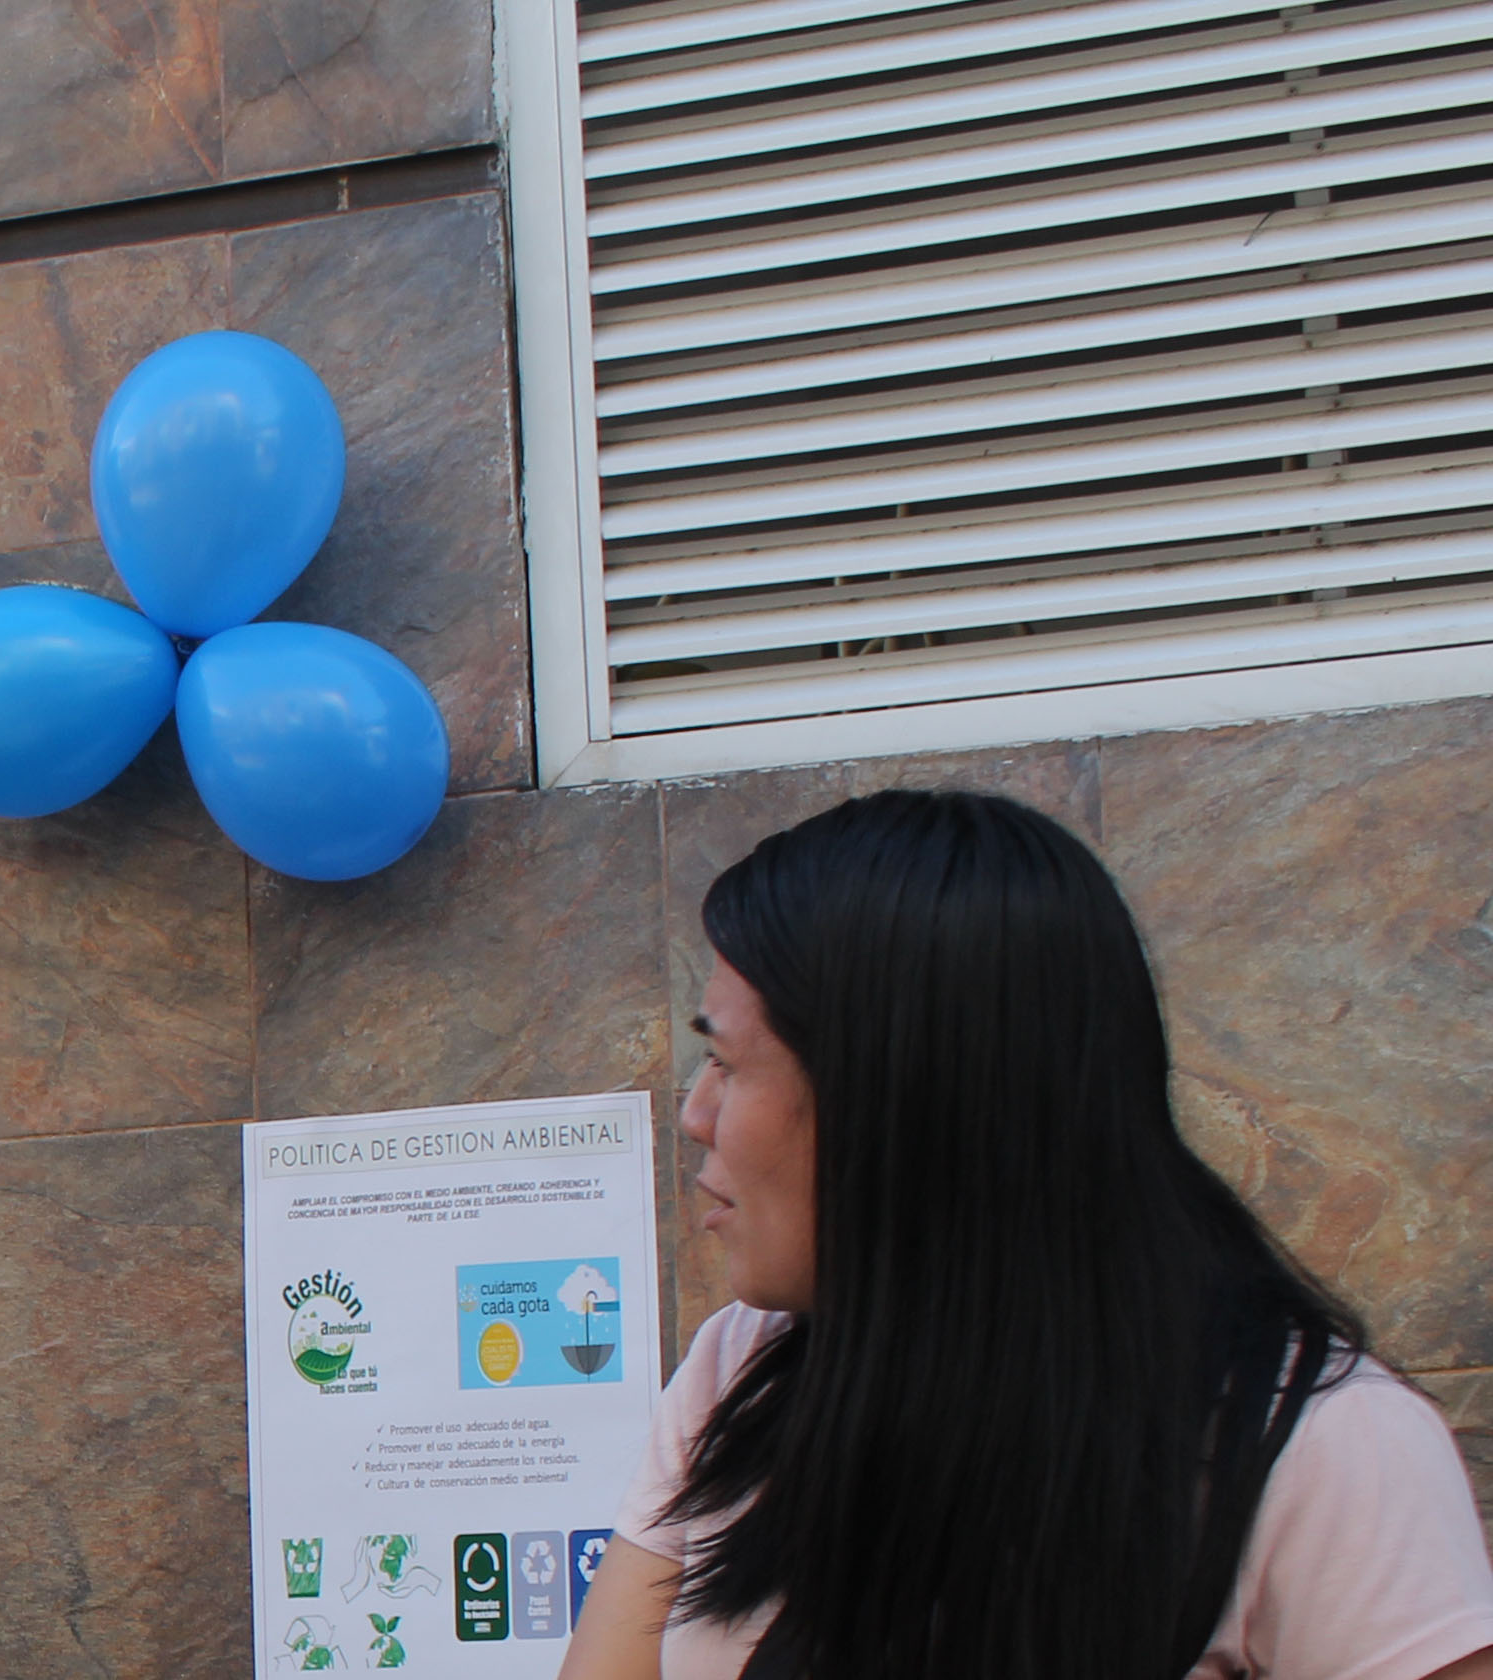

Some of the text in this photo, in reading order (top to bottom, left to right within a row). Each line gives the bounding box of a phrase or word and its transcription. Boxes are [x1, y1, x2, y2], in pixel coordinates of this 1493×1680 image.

[269, 1122, 624, 1168] POLITICA DE GESTION AMBIENTAL
[282, 1269, 363, 1318] Gestión
[480, 1280, 537, 1296] cuidamos
[481, 1297, 550, 1318] cada gota
[390, 1424, 433, 1436] Promover
[435, 1422, 443, 1434] el
[445, 1424, 461, 1433] uso
[465, 1421, 509, 1432] adecuado
[511, 1418, 525, 1430] del
[378, 1444, 422, 1454] Promover
[426, 1442, 435, 1452] el
[436, 1442, 453, 1452] uso
[457, 1438, 501, 1450] adecuado
[503, 1438, 513, 1449] de
[519, 1438, 527, 1448] la
[365, 1461, 398, 1472] Reducir
[407, 1461, 444, 1472] manejar
[448, 1456, 521, 1470] adecuadamente
[522, 1456, 535, 1466] los
[377, 1478, 410, 1490] Cultura
[414, 1478, 425, 1488] de
[489, 1474, 518, 1486] medio
